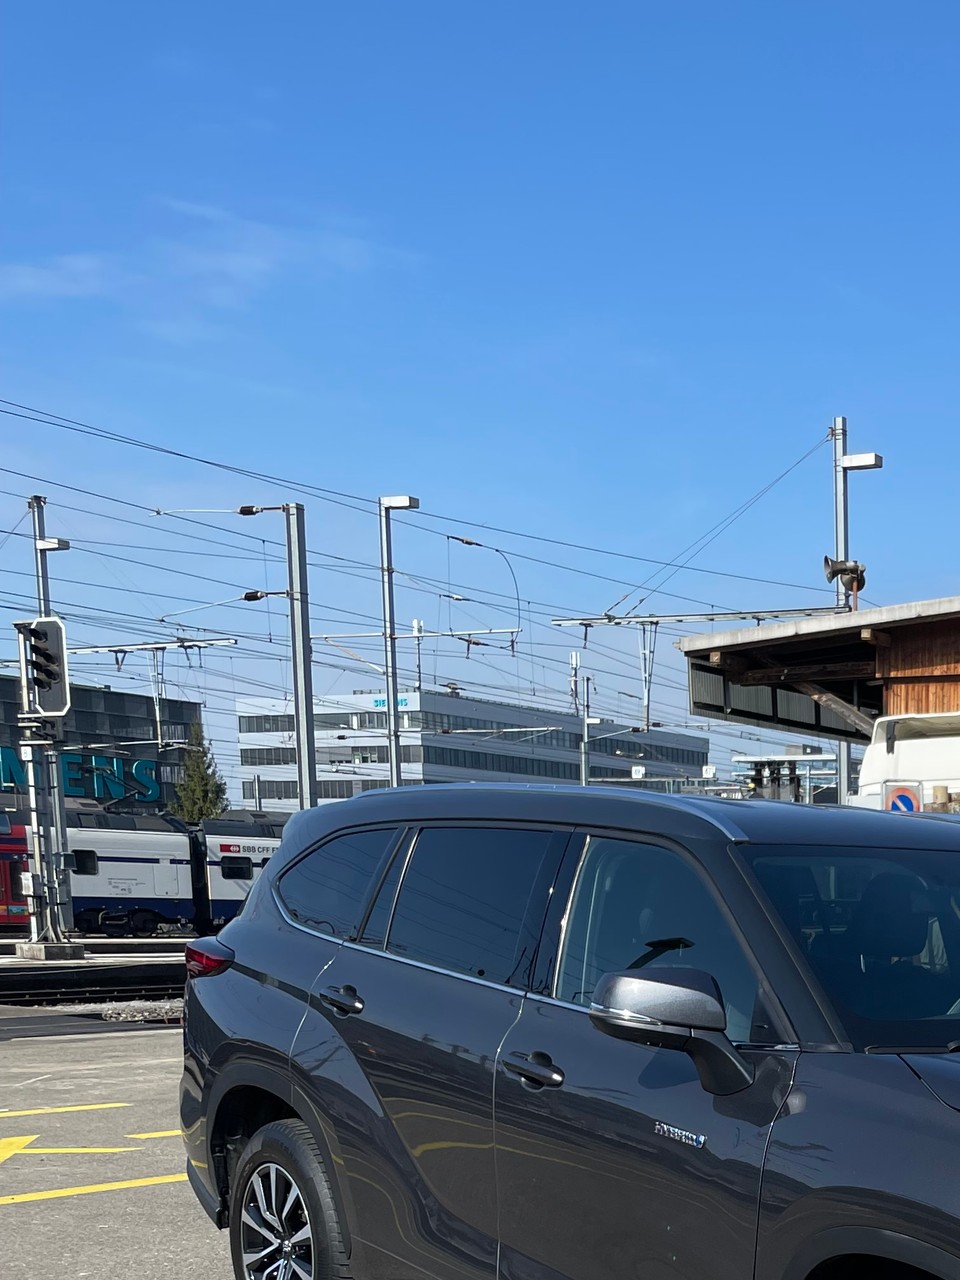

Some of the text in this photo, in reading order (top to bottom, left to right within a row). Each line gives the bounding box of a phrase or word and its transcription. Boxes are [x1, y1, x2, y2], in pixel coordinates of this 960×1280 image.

[374, 698, 408, 707] SIENS
[242, 845, 256, 853] SBB
[257, 846, 270, 854] CFF
[654, 1121, 697, 1147] HYBRID
